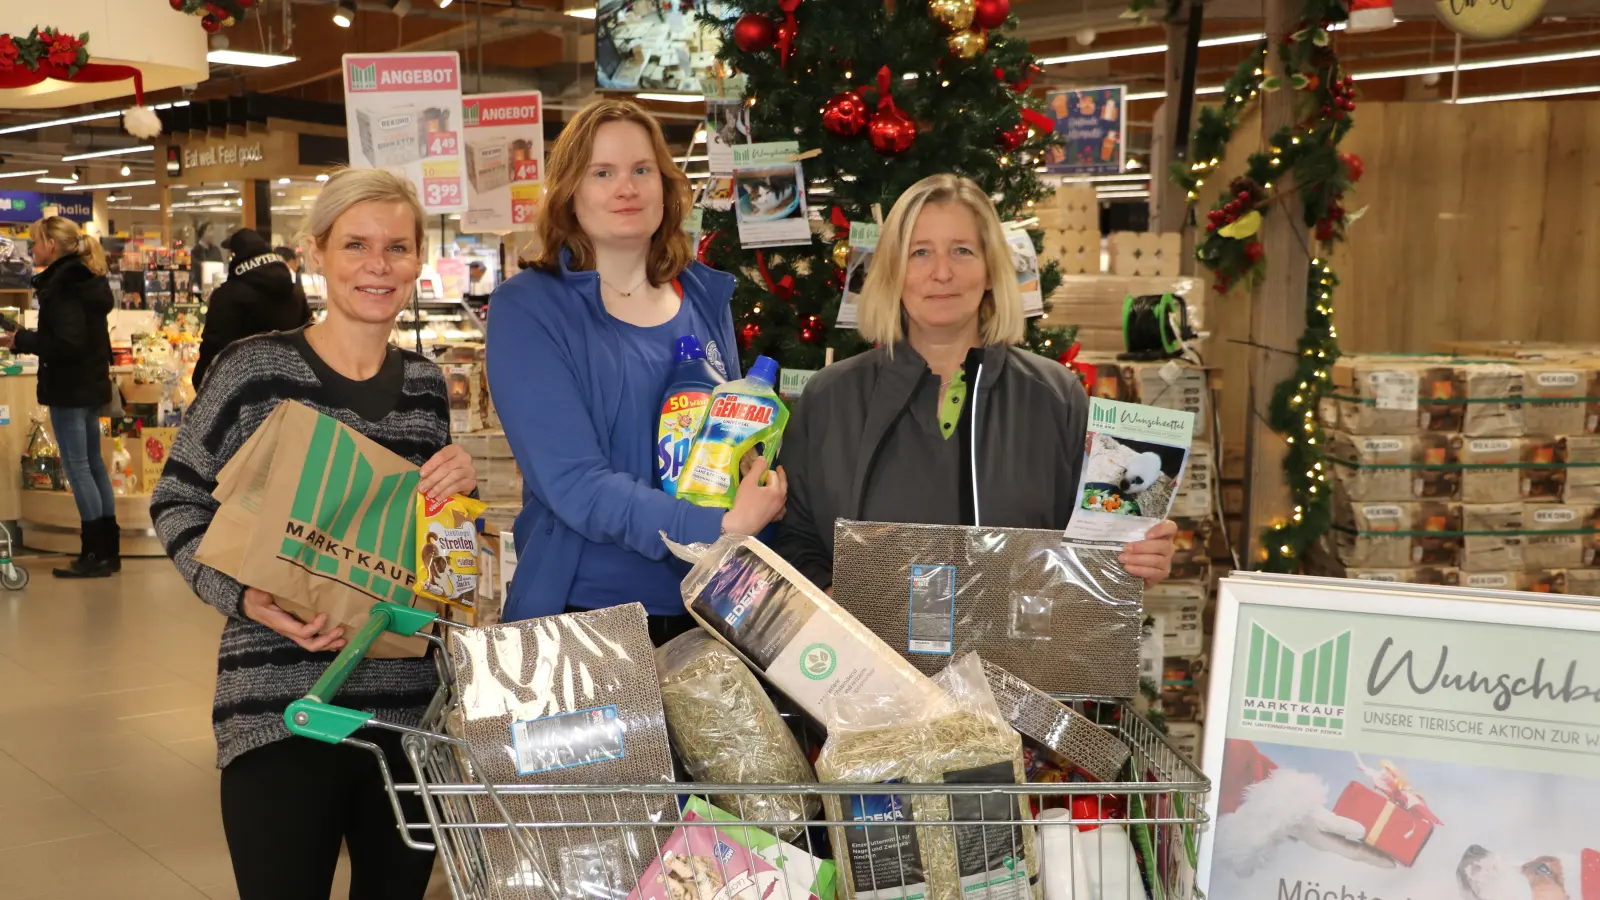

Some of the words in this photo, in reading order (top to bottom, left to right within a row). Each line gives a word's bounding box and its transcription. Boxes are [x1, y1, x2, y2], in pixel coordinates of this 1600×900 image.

[381, 69, 453, 85] ANGEBOT
[482, 106, 536, 121] ANGEBOT
[184, 150, 198, 169] Eat
[200, 149, 217, 166] well.
[219, 146, 237, 164] Feel
[239, 143, 263, 167] good.
[57, 204, 90, 215] halia
[670, 395, 689, 411] 50
[726, 394, 739, 402] DER
[710, 397, 773, 425] GENERAL
[1120, 410, 1185, 430] Wunschzettel
[285, 520, 417, 586] MARKTKAUF
[724, 579, 770, 626] EDEKA
[1243, 699, 1345, 717] MARKTKAUF
[1363, 711, 1413, 728] UNSERE
[1418, 716, 1484, 735] TIERISCHE
[1489, 725, 1546, 742] AKTION
[1551, 729, 1580, 745] ZUR
